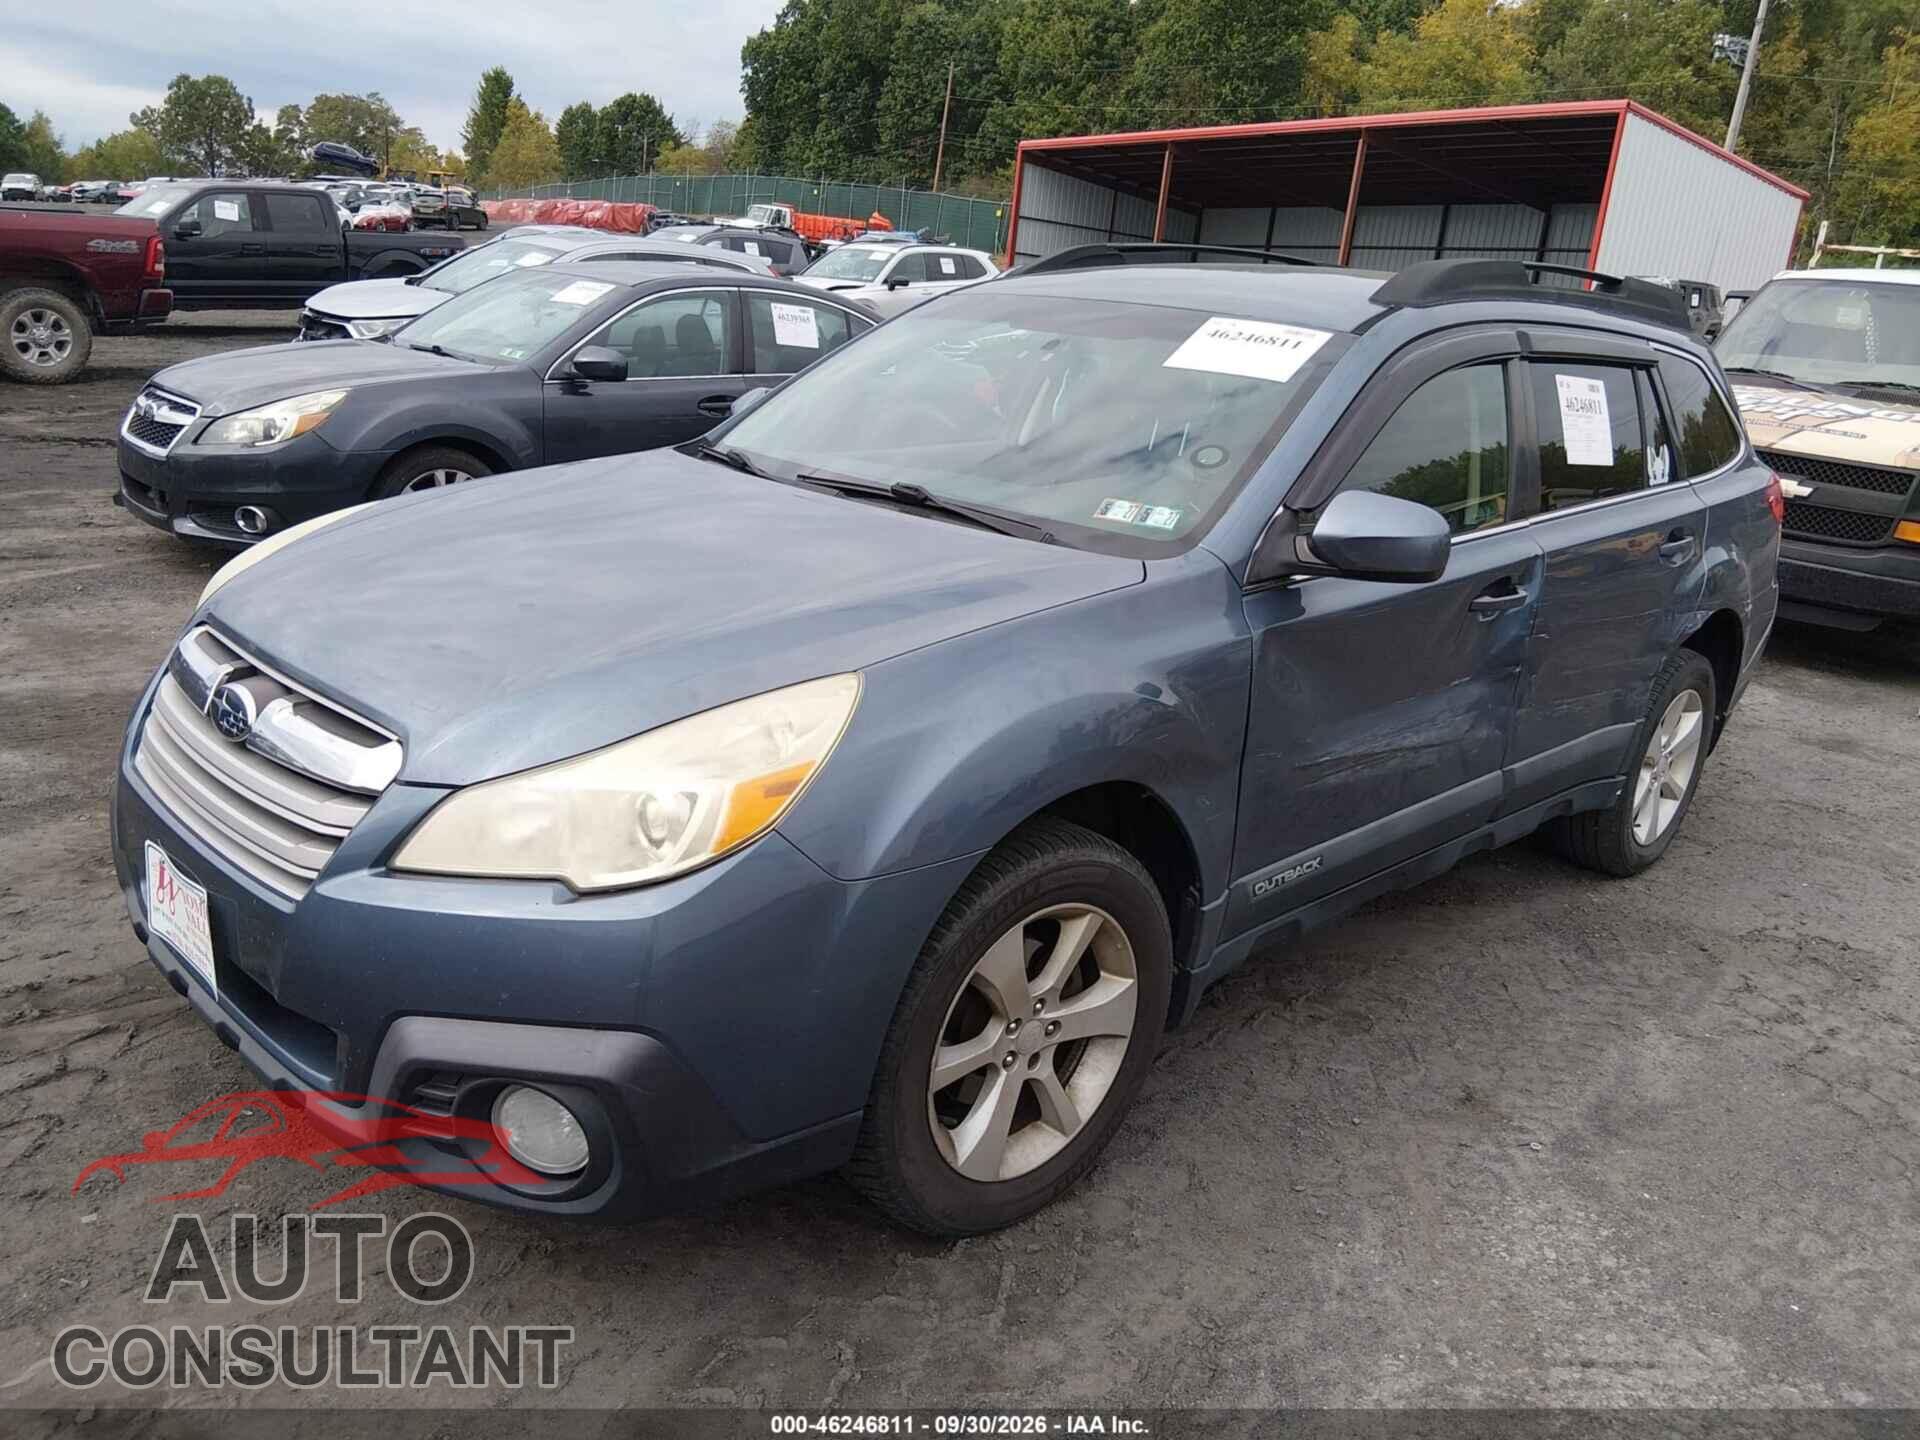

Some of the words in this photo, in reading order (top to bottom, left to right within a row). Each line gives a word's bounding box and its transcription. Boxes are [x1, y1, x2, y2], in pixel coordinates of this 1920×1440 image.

[1207, 328, 1304, 350] 46246811
[1565, 396, 1602, 415] 46246811
[1254, 856, 1322, 895] OUTBACK
